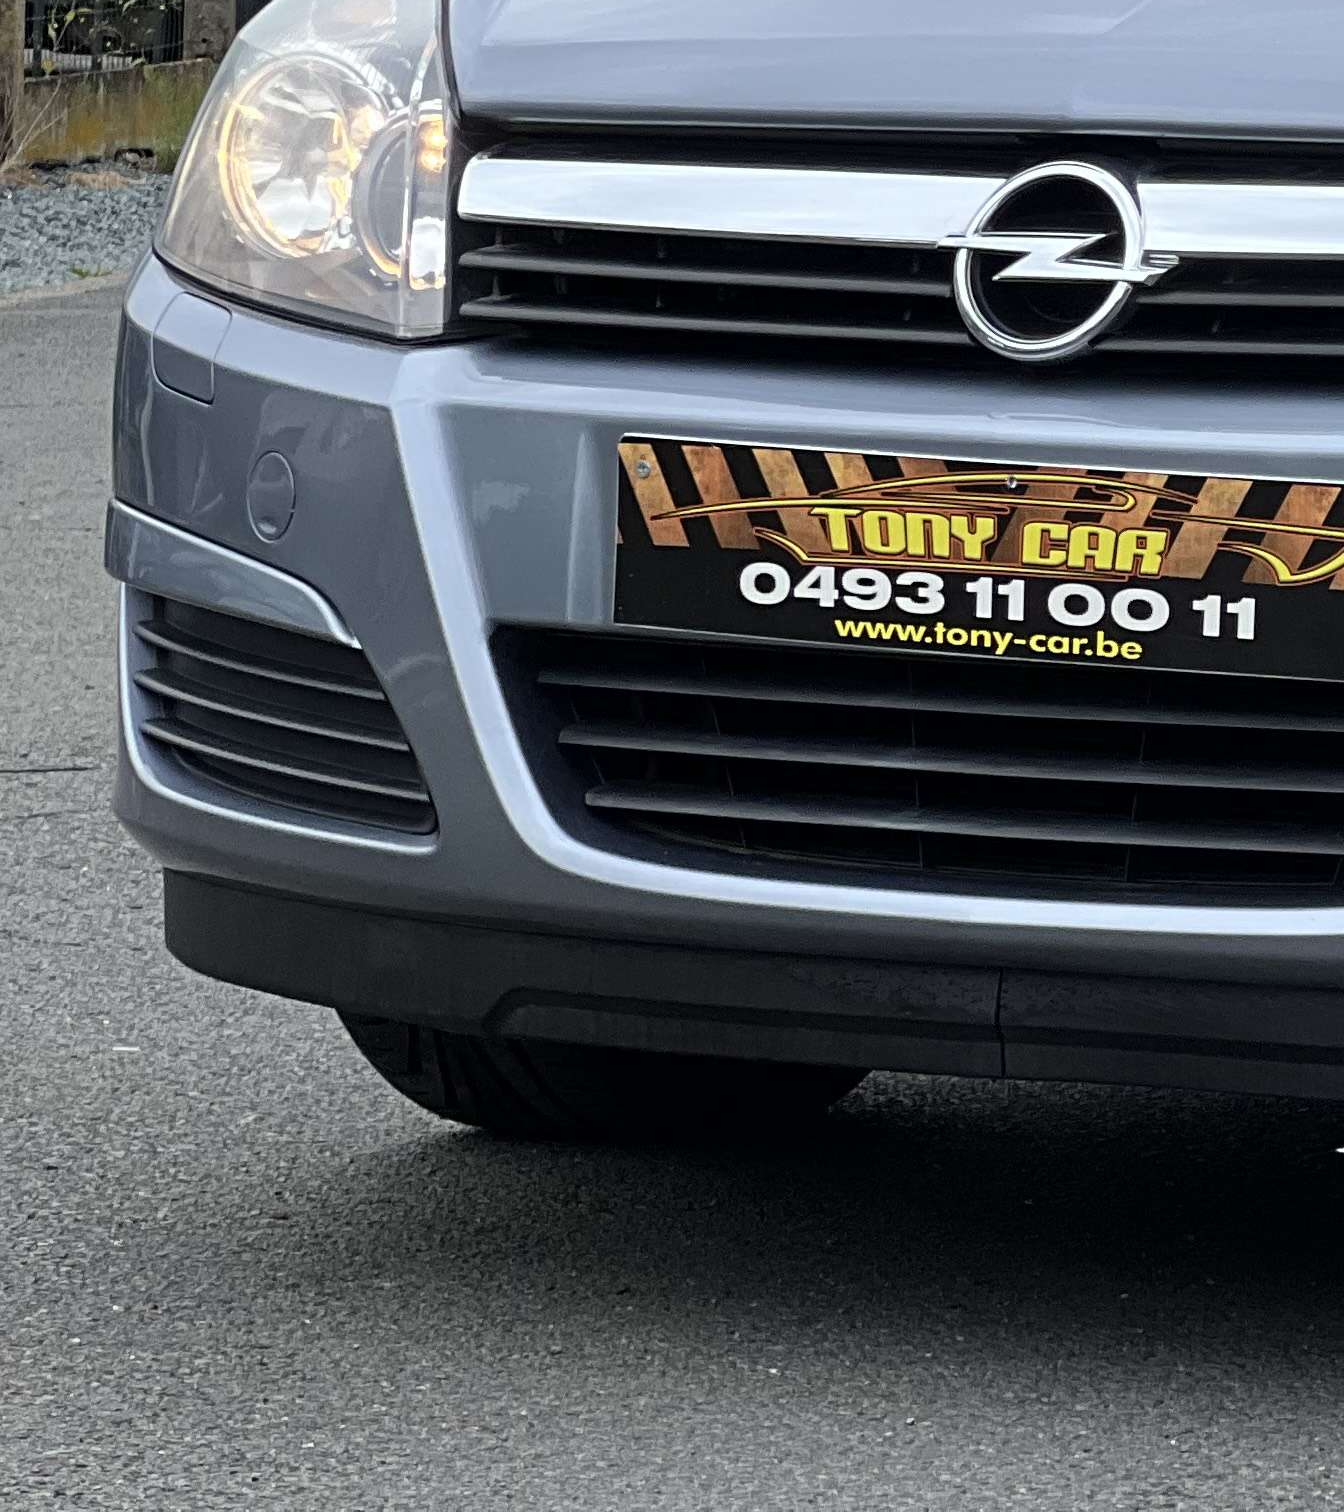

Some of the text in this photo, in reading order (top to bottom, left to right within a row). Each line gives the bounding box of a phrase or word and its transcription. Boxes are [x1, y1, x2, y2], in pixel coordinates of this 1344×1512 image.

[810, 506, 1168, 576] TONY CAR
[739, 561, 1256, 641] 0493 11 00 11
[834, 618, 1143, 660] www.tony-car.be
